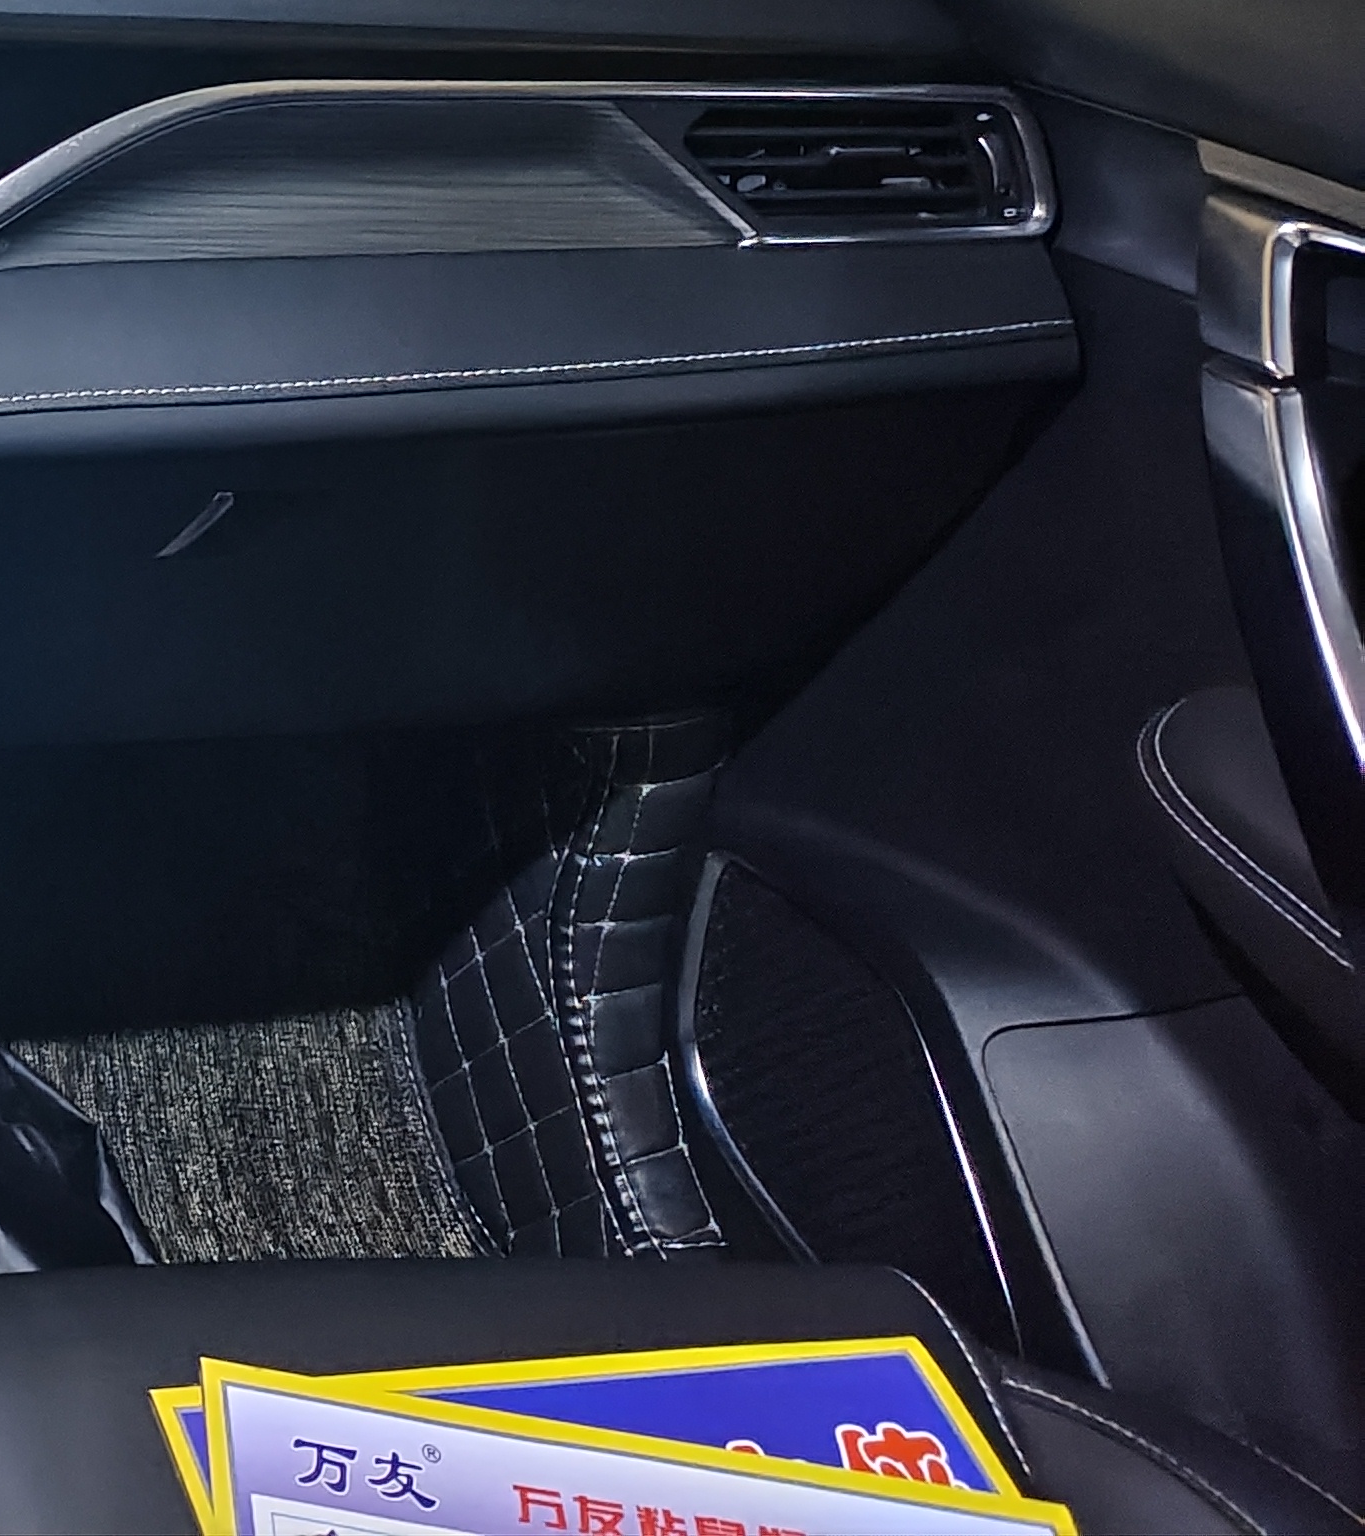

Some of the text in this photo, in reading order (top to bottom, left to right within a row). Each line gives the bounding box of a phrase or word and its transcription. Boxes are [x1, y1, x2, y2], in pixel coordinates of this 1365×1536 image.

[291, 1437, 439, 1509] 万友
[510, 1483, 808, 1536] 万友粘
